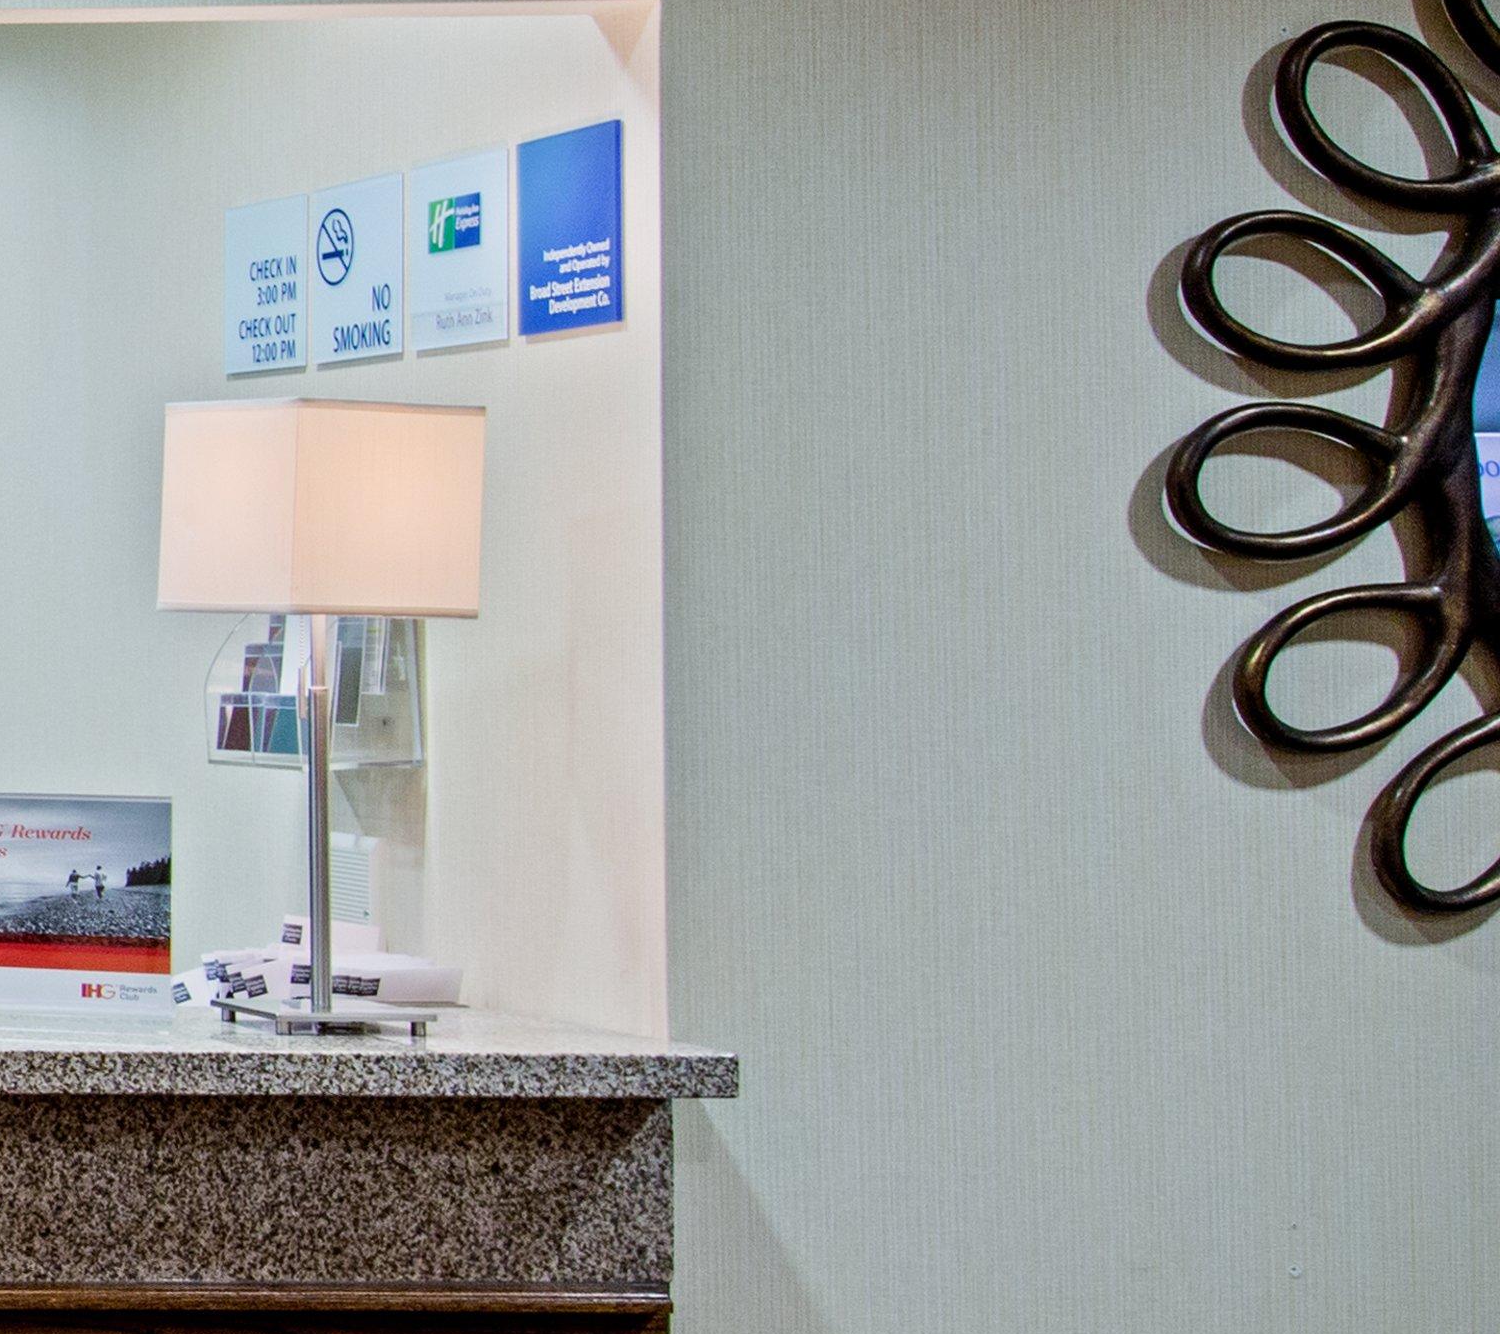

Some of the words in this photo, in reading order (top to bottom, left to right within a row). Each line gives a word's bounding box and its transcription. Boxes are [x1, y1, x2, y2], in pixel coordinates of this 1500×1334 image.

[249, 257, 282, 281] CHECK
[286, 255, 297, 276] IN
[257, 284, 278, 306] 3:00
[281, 281, 297, 302] PM
[372, 283, 392, 311] NO
[238, 317, 271, 340] CHECK
[274, 313, 297, 335] OUT
[333, 319, 392, 353] SMOKING
[252, 341, 278, 363] 12:00
[280, 339, 296, 360] PM
[10, 823, 92, 841] Rewards
[81, 983, 116, 1000] IHG
